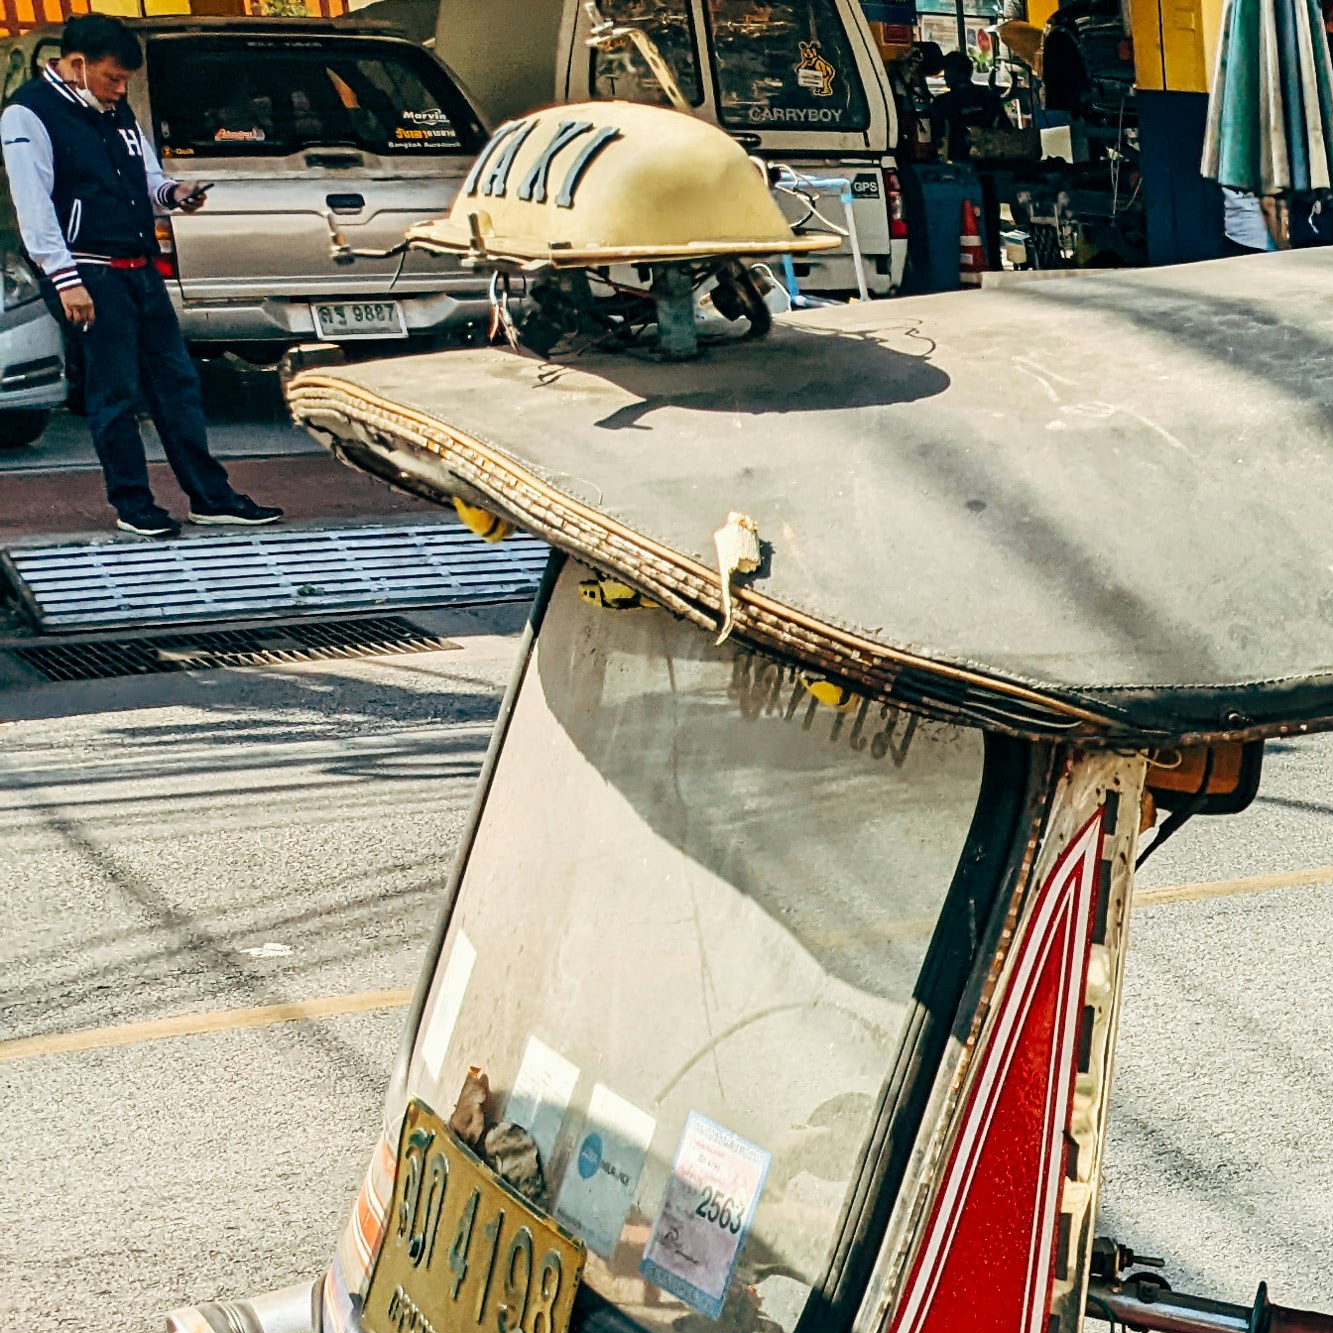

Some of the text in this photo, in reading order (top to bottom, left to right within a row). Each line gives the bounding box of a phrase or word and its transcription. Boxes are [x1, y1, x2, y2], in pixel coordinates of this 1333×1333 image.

[402, 111, 447, 120] Marvin
[749, 108, 842, 122] CARRYBOY
[117, 128, 142, 156] H
[465, 118, 623, 208] TAXI
[853, 181, 878, 192] GPS
[397, 1126, 449, 1268] สก
[695, 1185, 745, 1235] 2563
